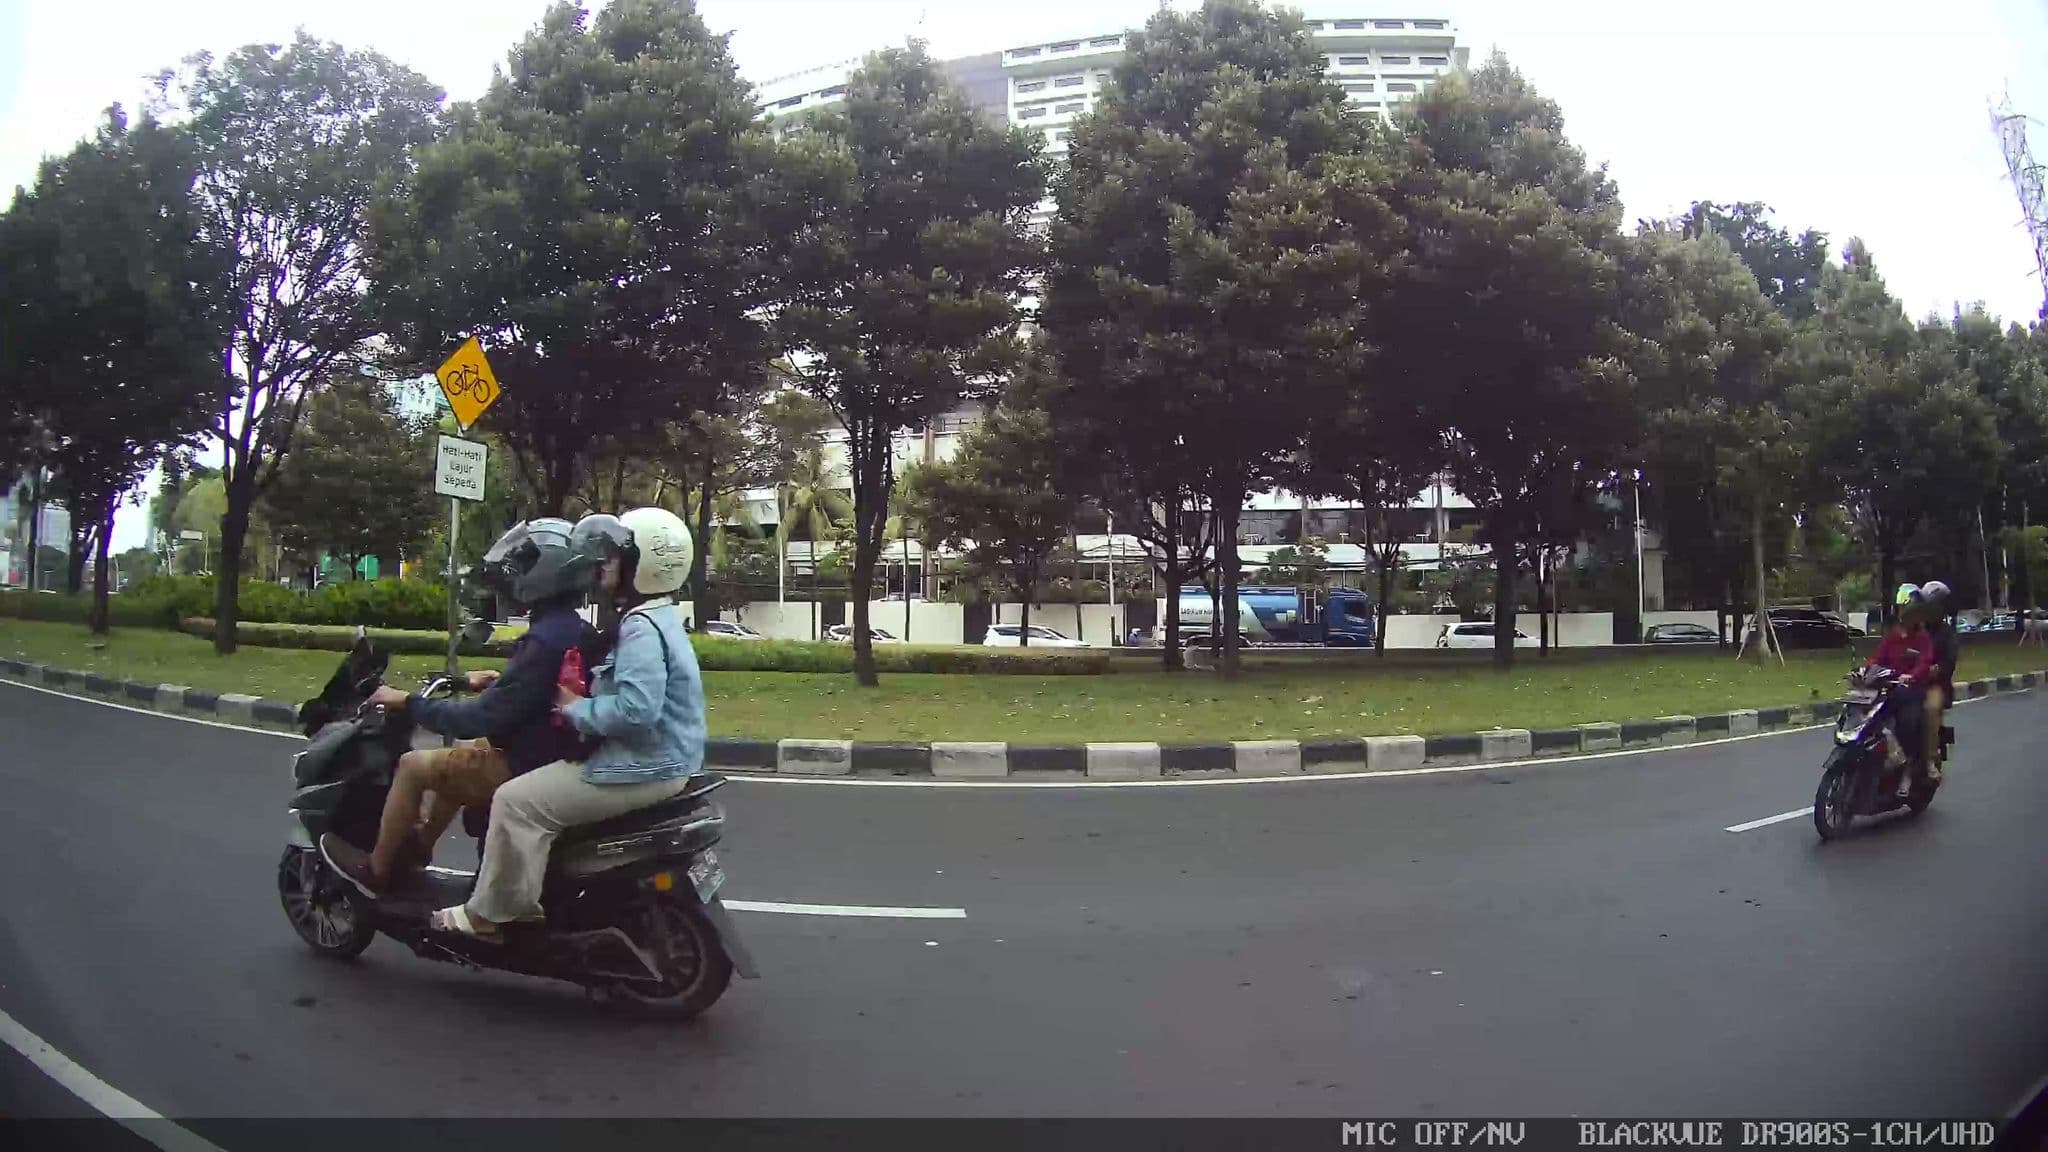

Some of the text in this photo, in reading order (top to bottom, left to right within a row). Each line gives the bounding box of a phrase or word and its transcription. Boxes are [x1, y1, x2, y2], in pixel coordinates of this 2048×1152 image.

[442, 445, 481, 461] Hati-Hati
[450, 462, 474, 475] Lajur
[443, 475, 477, 489] Sepeda
